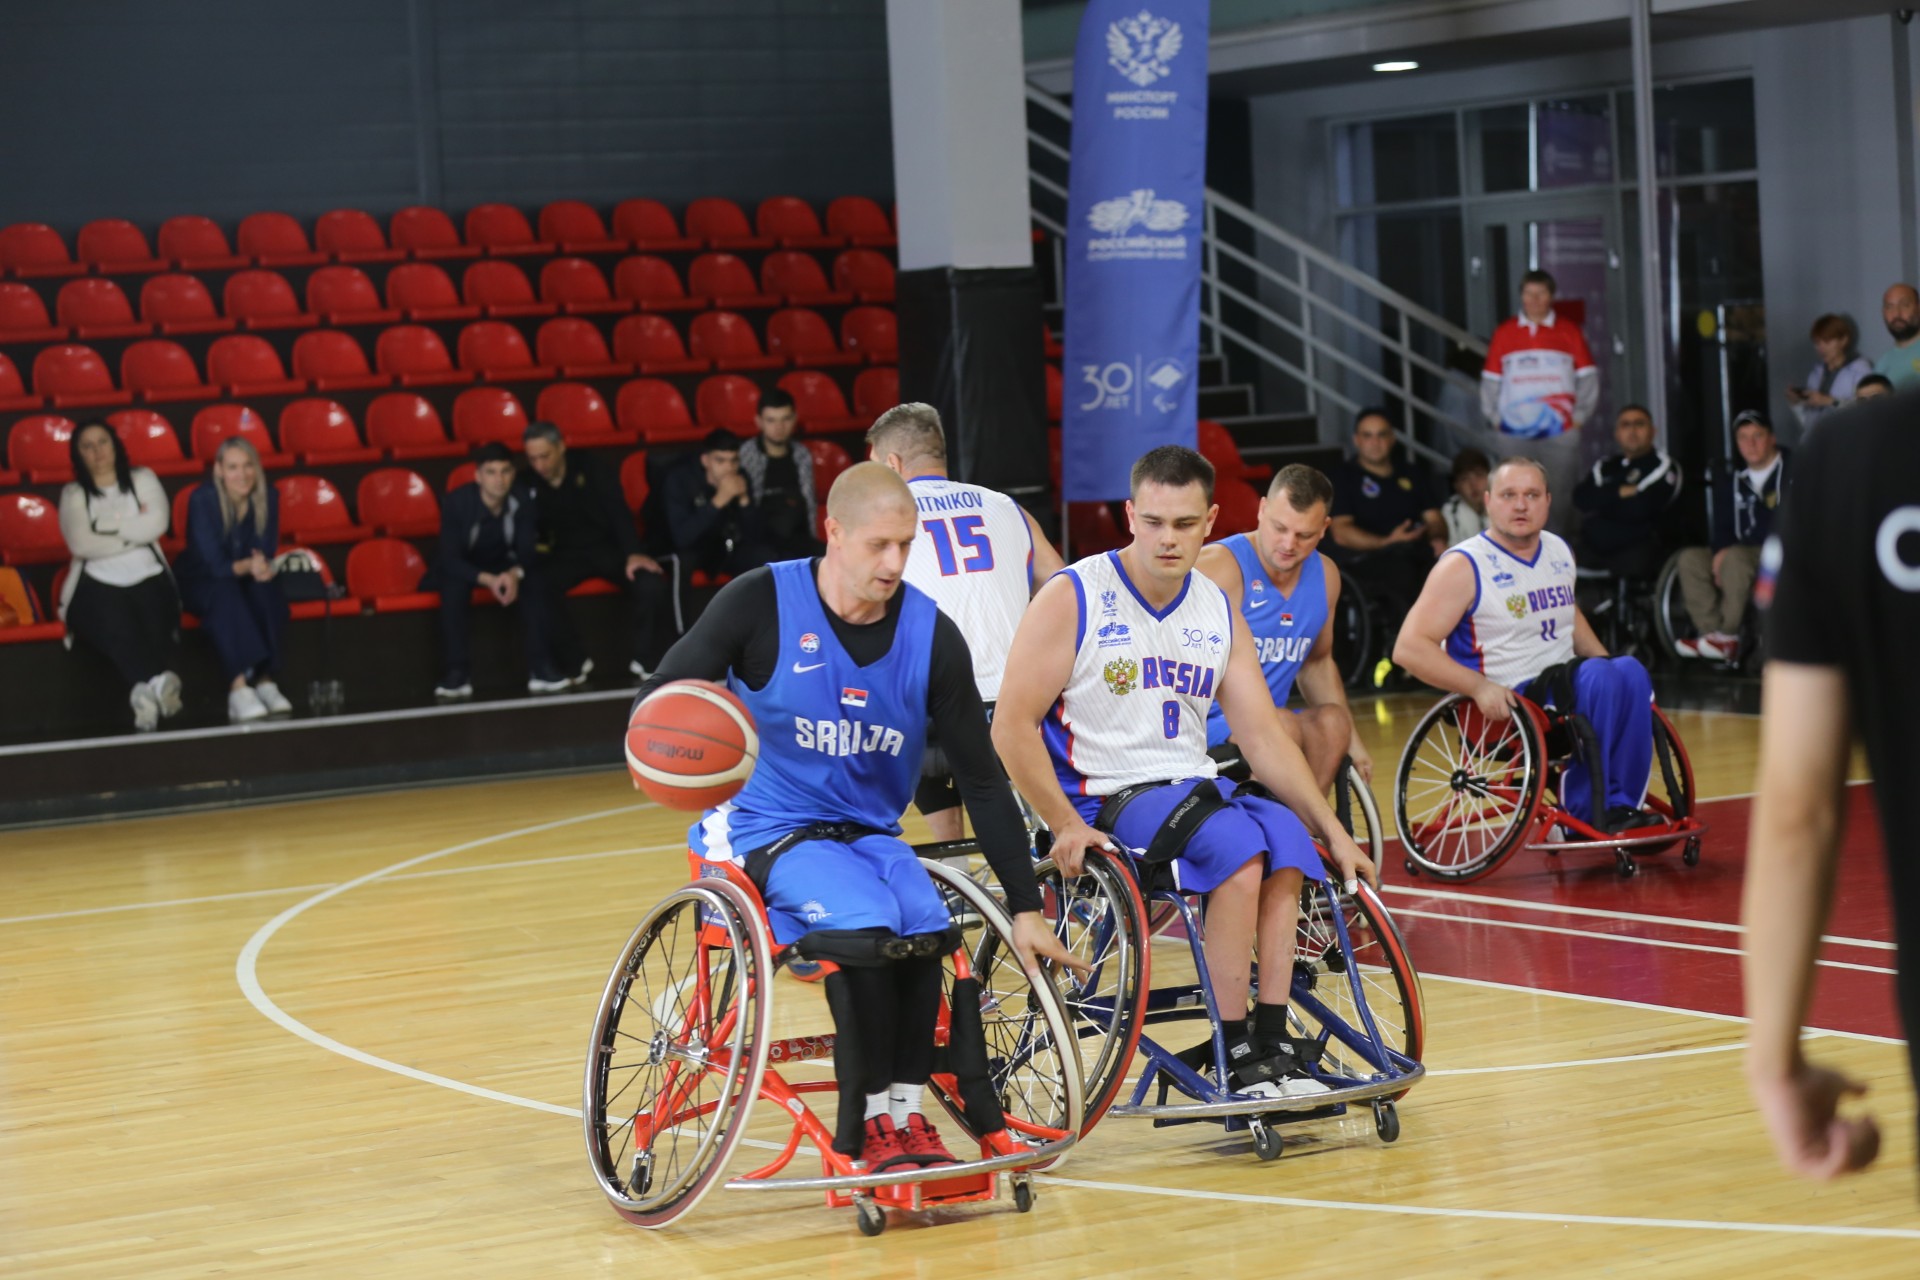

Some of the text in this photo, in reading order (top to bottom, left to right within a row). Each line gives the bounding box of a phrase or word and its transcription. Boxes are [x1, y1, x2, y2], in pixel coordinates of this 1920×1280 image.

[1113, 106, 1170, 119] РОССИИ
[1081, 361, 1133, 411] 30
[916, 490, 983, 513] ITNIKOV
[921, 514, 995, 577] 15
[1181, 627, 1204, 647] 30
[795, 715, 905, 758] SRBIJA
[1162, 699, 1181, 740] 8
